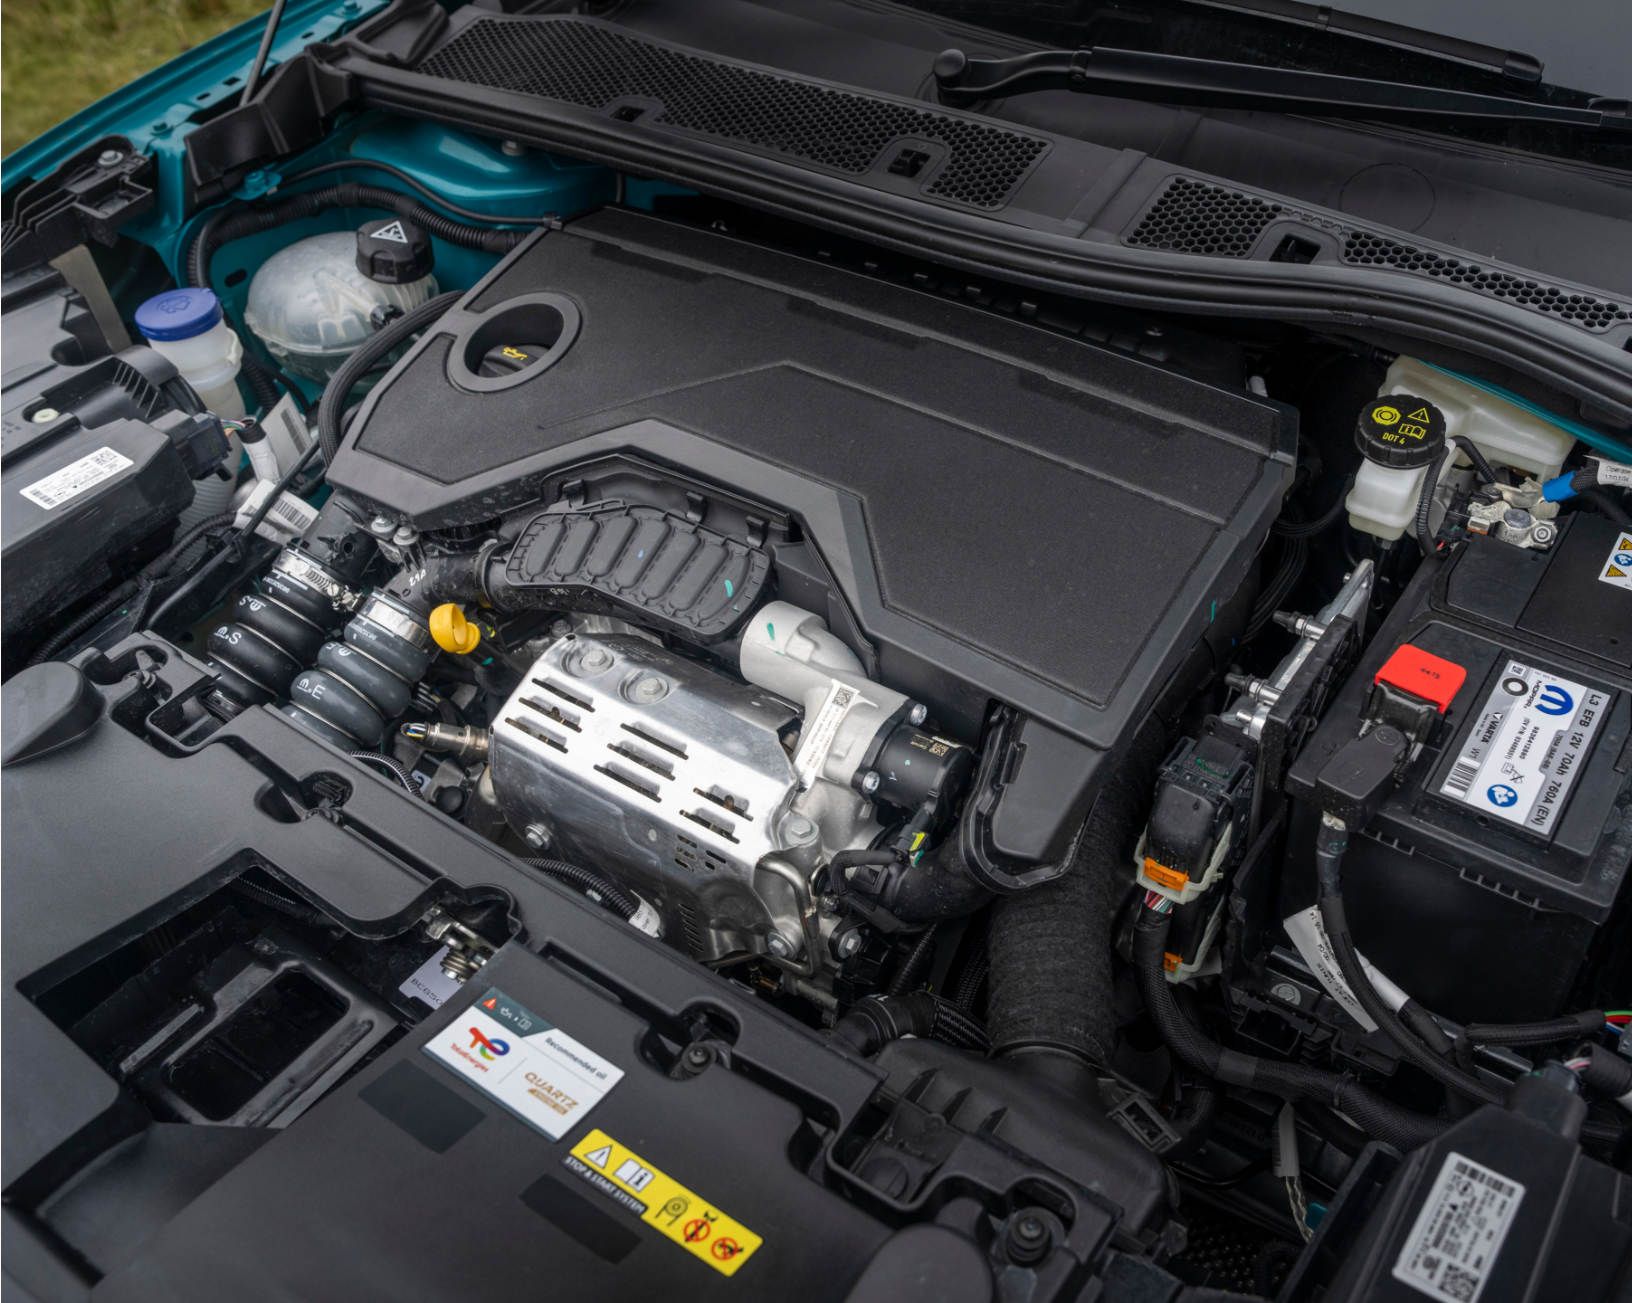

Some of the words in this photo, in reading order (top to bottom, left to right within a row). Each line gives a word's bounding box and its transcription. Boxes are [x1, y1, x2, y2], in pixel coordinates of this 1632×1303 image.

[1382, 432, 1399, 442] DOT
[1589, 694, 1602, 706] L3
[1579, 710, 1595, 728] EFB
[1481, 719, 1500, 745] VARTA
[1569, 733, 1584, 749] 12V
[1556, 752, 1575, 775] 70Ah
[1544, 780, 1562, 805] 760A
[1531, 804, 1549, 826] (EN)
[450, 1043, 489, 1072] TotalEnergies
[544, 1036, 598, 1075] Recommended
[595, 1069, 608, 1081] oil
[524, 1071, 579, 1108] QUARTZ
[565, 1156, 587, 1172] STOP
[590, 1173, 618, 1193] START
[613, 1190, 646, 1214] SYSTEM
